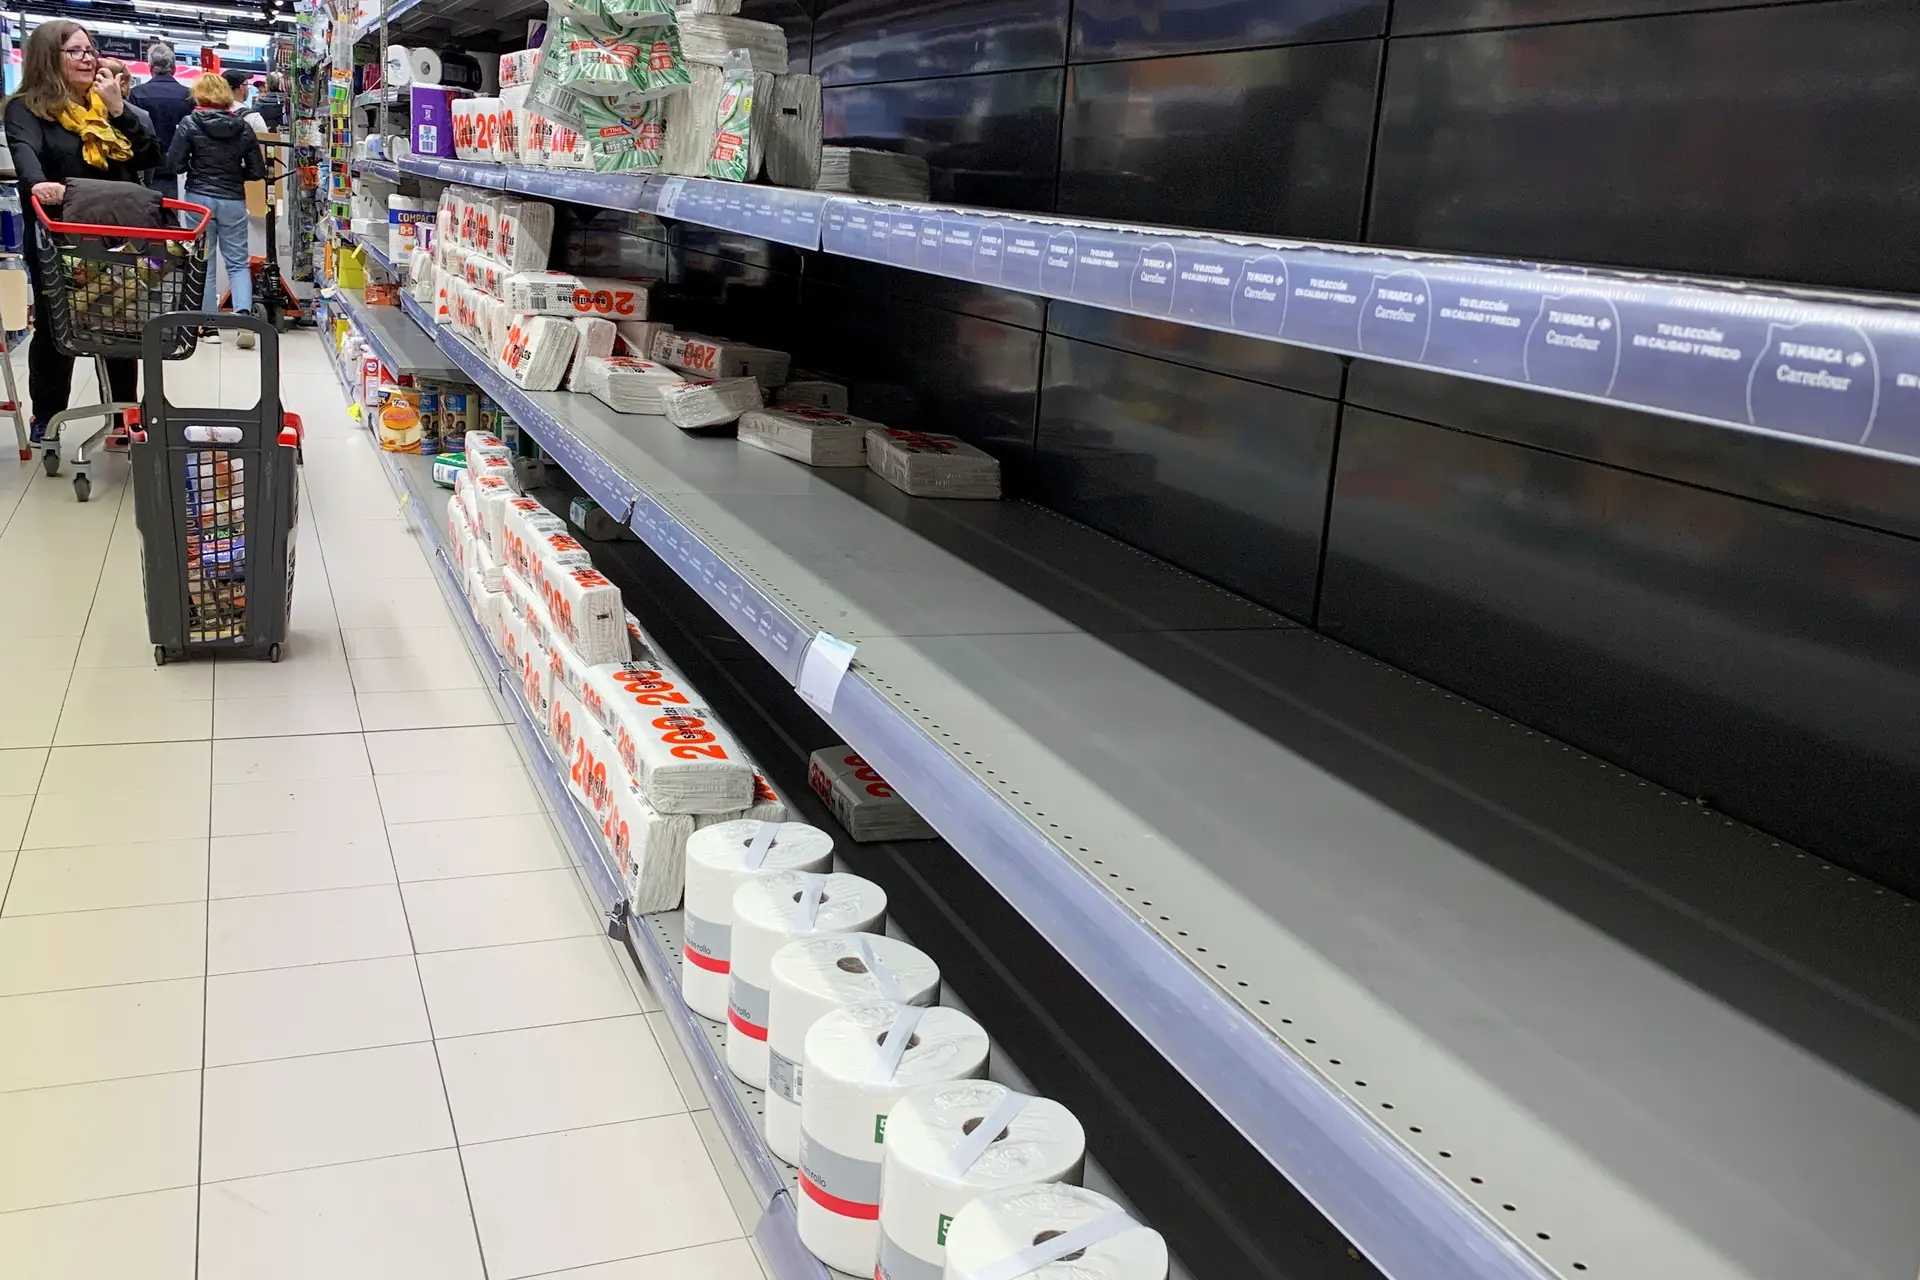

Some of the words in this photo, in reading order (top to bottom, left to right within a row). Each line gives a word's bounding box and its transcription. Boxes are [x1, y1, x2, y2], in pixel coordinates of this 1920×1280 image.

[573, 288, 634, 315] 200
[1244, 286, 1277, 301] Carrefour
[1387, 289, 1413, 303] MARCA
[1375, 304, 1417, 322] Carrefour
[1560, 312, 1596, 328] MARCA
[1545, 329, 1601, 351] Carrefour
[682, 342, 717, 371] 200
[1796, 344, 1843, 364] MARCA
[1776, 363, 1852, 391] Carrefour
[612, 670, 691, 706] 200
[651, 716, 728, 760] 200
[571, 736, 606, 811] 200
[604, 789, 630, 876] 200
[696, 943, 711, 955] rollo
[736, 1005, 751, 1020] rollo
[811, 1169, 827, 1189] rollo
